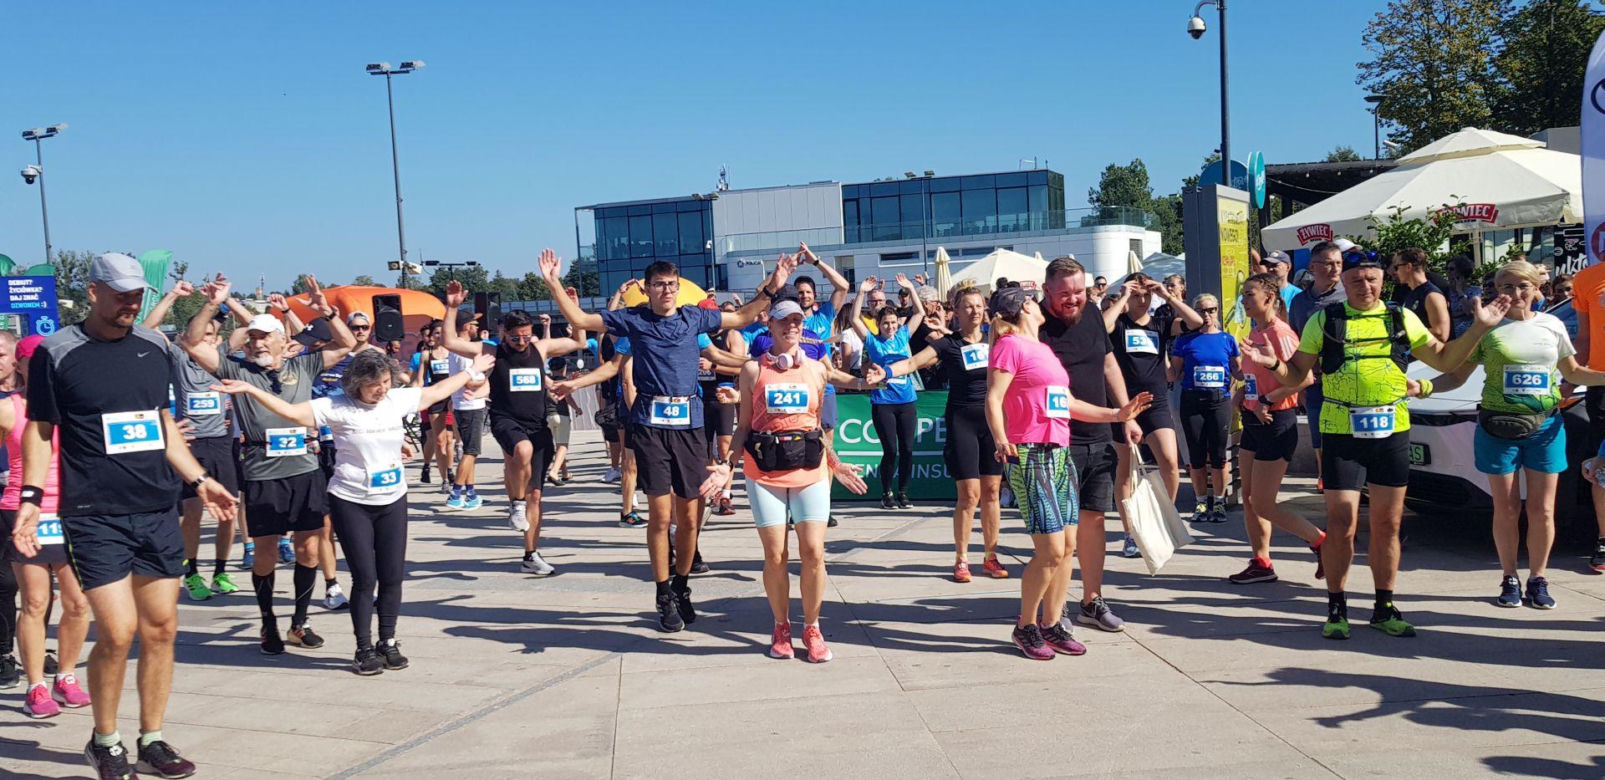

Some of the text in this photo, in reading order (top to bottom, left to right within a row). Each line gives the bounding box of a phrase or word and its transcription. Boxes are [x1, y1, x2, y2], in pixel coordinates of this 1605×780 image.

[1512, 374, 1542, 385] 626
[193, 400, 214, 408] 259
[774, 392, 800, 405] 241
[664, 406, 680, 417] 48
[1360, 416, 1388, 429] 118
[122, 424, 147, 440] 38
[278, 437, 297, 448] 32
[380, 472, 397, 484] 33
